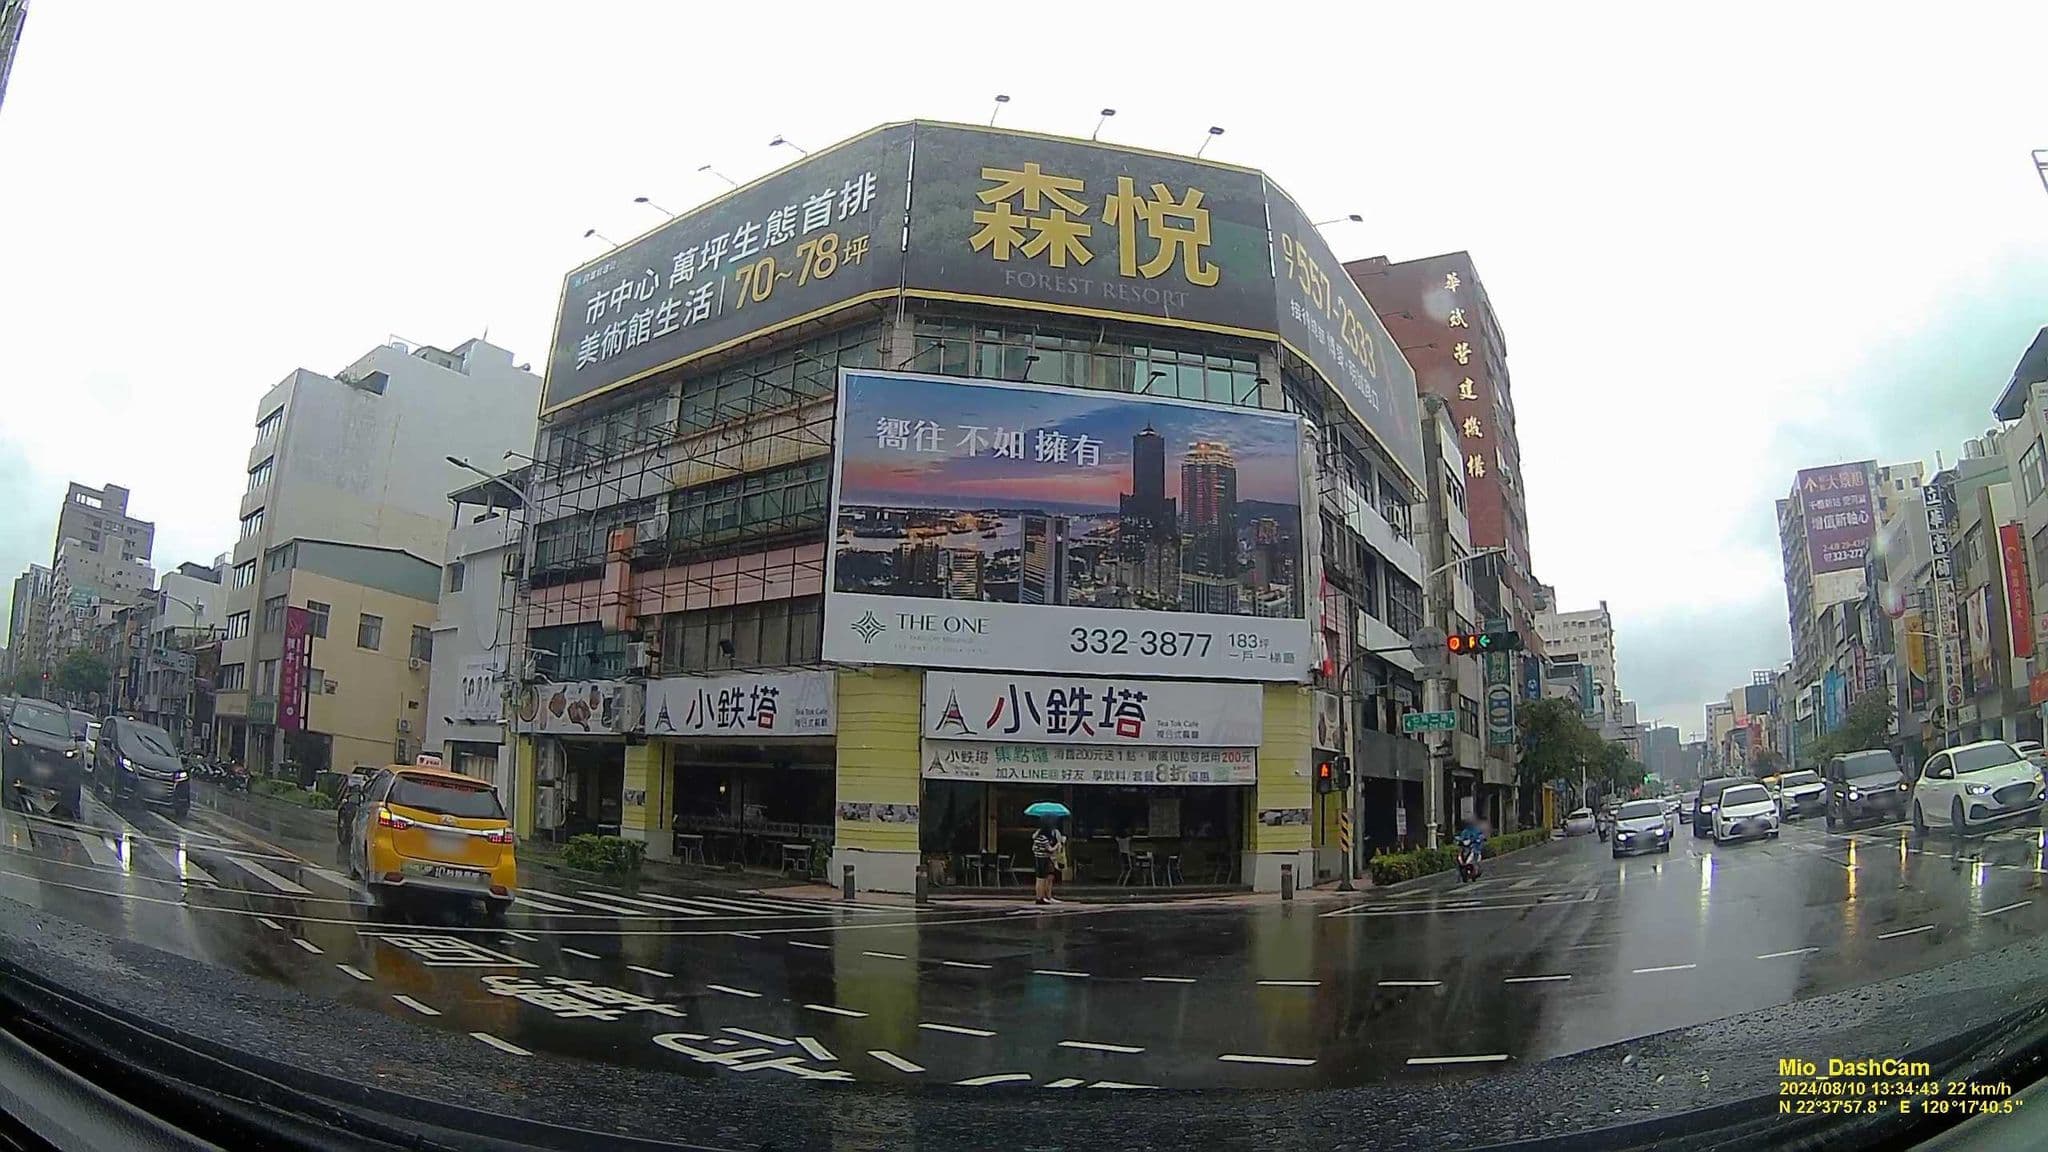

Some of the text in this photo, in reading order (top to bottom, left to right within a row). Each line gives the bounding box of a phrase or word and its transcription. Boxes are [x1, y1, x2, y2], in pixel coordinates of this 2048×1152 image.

[584, 172, 878, 324] 市中心 萬坪生態首排
[1005, 269, 1190, 308] FOREST RESORT
[576, 282, 714, 370] 美術館生活
[876, 416, 1104, 466] 嚮往 不如 擁有
[896, 613, 990, 635] THE ONE
[1070, 627, 1212, 657] 332-3877
[986, 684, 1149, 738] 小鉄塔
